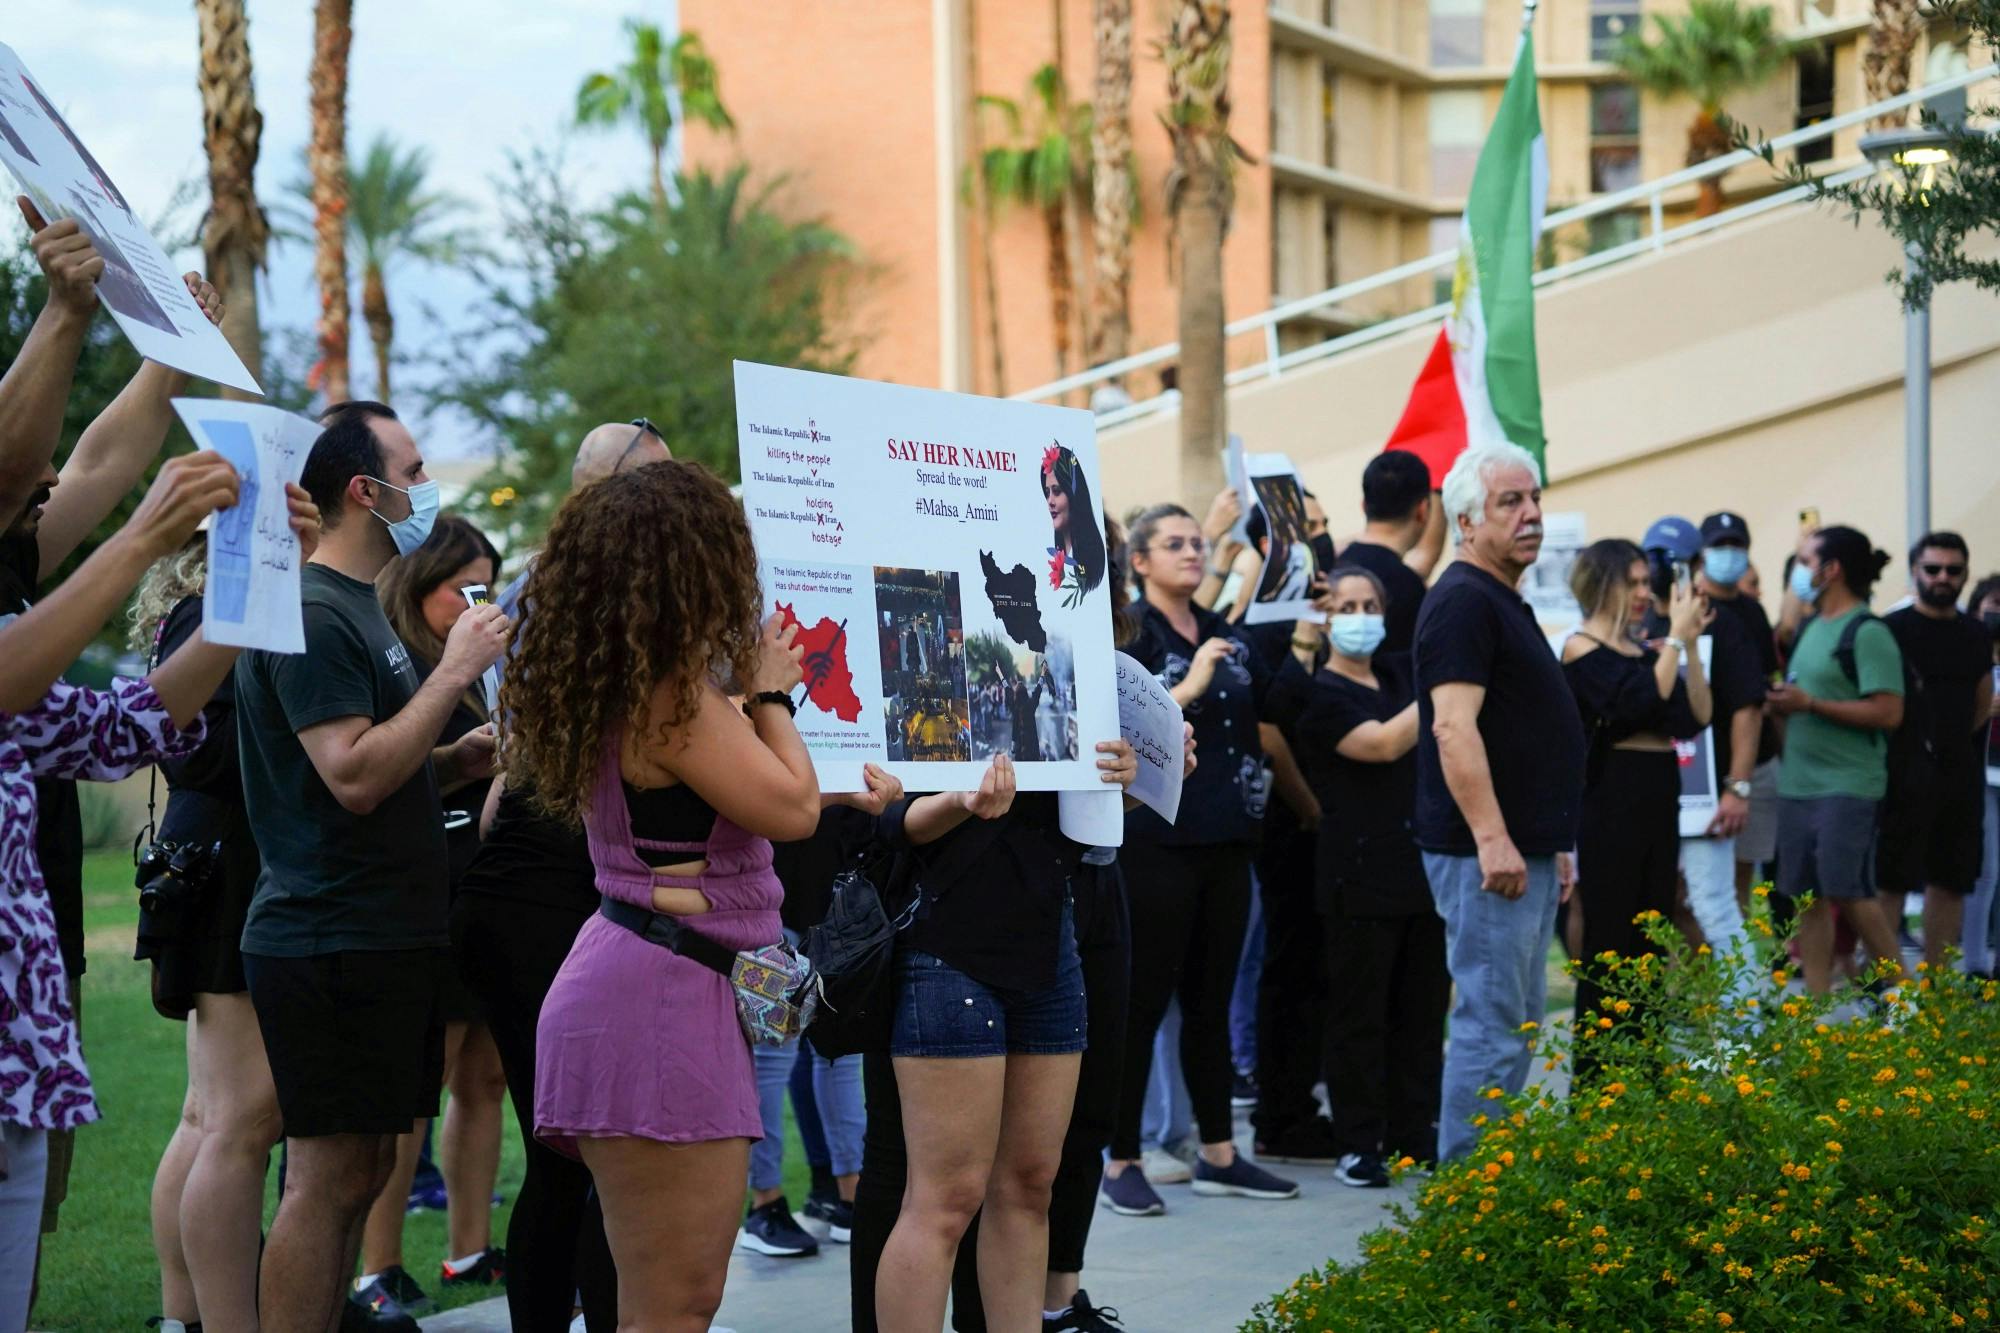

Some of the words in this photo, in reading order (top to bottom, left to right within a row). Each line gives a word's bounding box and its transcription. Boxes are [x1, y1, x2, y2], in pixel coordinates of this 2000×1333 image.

[808, 417, 816, 428] in
[749, 424, 761, 433] The
[762, 425, 783, 436] Islamic
[784, 428, 810, 440] Republic
[818, 433, 831, 441] Iran
[767, 446, 791, 464] killing
[792, 450, 804, 462] the
[807, 454, 831, 467] people
[887, 438, 919, 461] SAY
[923, 442, 960, 466] HER
[962, 447, 1017, 472] NAME!
[752, 471, 764, 481] The
[766, 472, 787, 483] Islamic
[788, 476, 814, 487] Republic
[822, 480, 835, 488] Iran
[916, 468, 945, 486] Spread
[948, 472, 961, 486] the
[963, 475, 988, 489] word!
[806, 496, 833, 513] holding
[915, 497, 999, 523] #Mahsa_Amini
[756, 508, 767, 517] The
[768, 509, 789, 520] Islamic
[790, 512, 817, 524] Republic
[825, 515, 838, 524] Iran
[812, 531, 842, 547] hostage
[774, 567, 785, 576] The
[786, 568, 806, 577] Islamic
[807, 570, 832, 580] Republic
[833, 571, 839, 580] of
[841, 572, 852, 580] Iran
[775, 581, 787, 590] Has
[788, 582, 801, 591] shut
[802, 583, 818, 592] down
